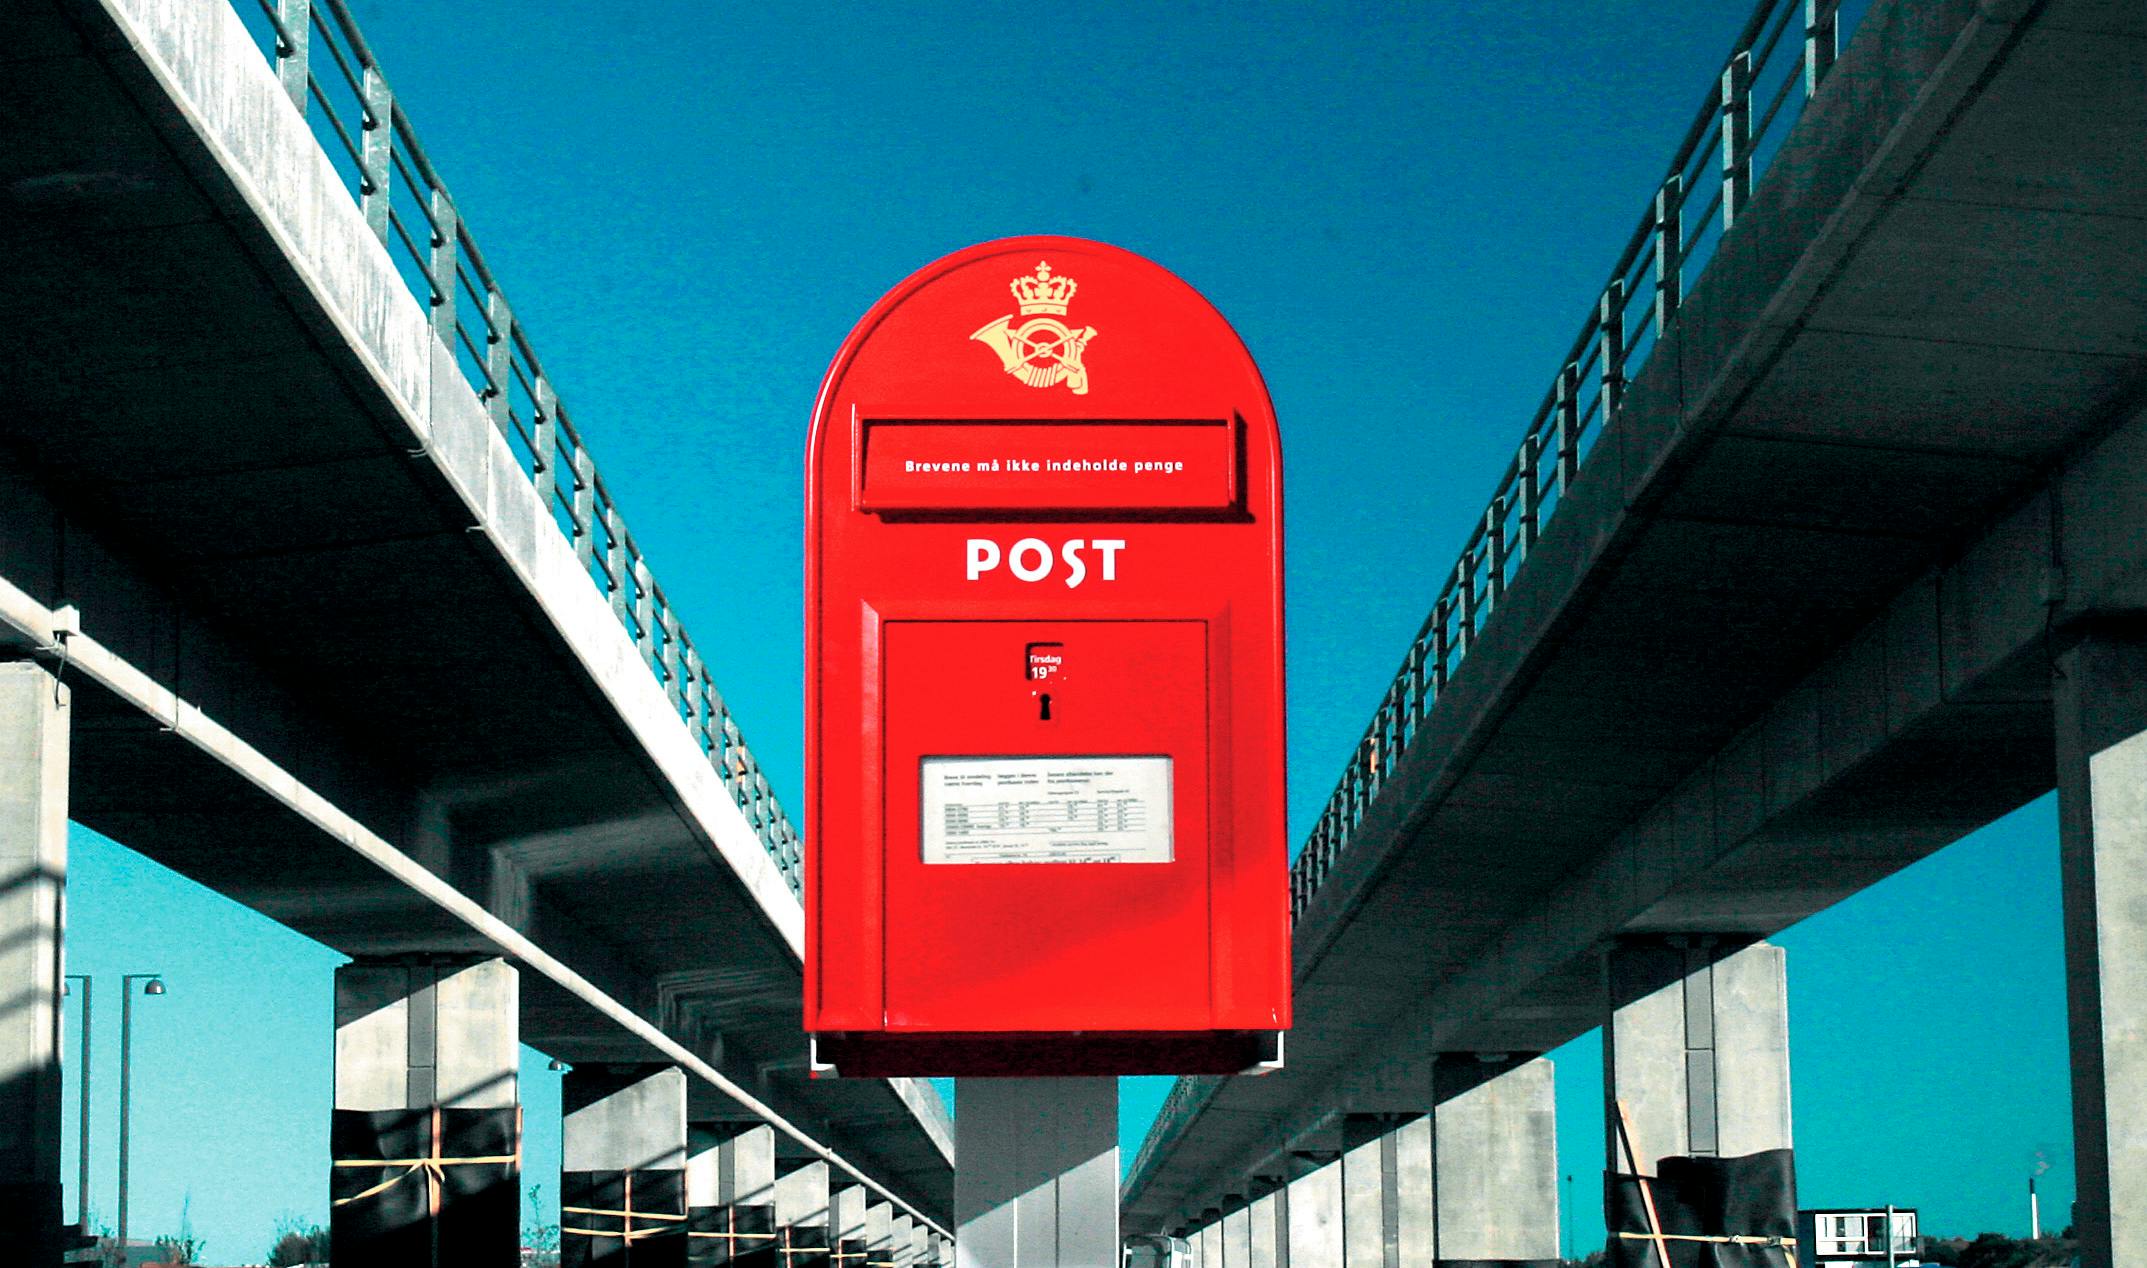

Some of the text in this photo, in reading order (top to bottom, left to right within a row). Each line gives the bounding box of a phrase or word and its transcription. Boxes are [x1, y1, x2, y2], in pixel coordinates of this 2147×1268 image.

[905, 459, 1183, 473] Brevene må ikke indeholde penge
[966, 537, 1126, 589] POST
